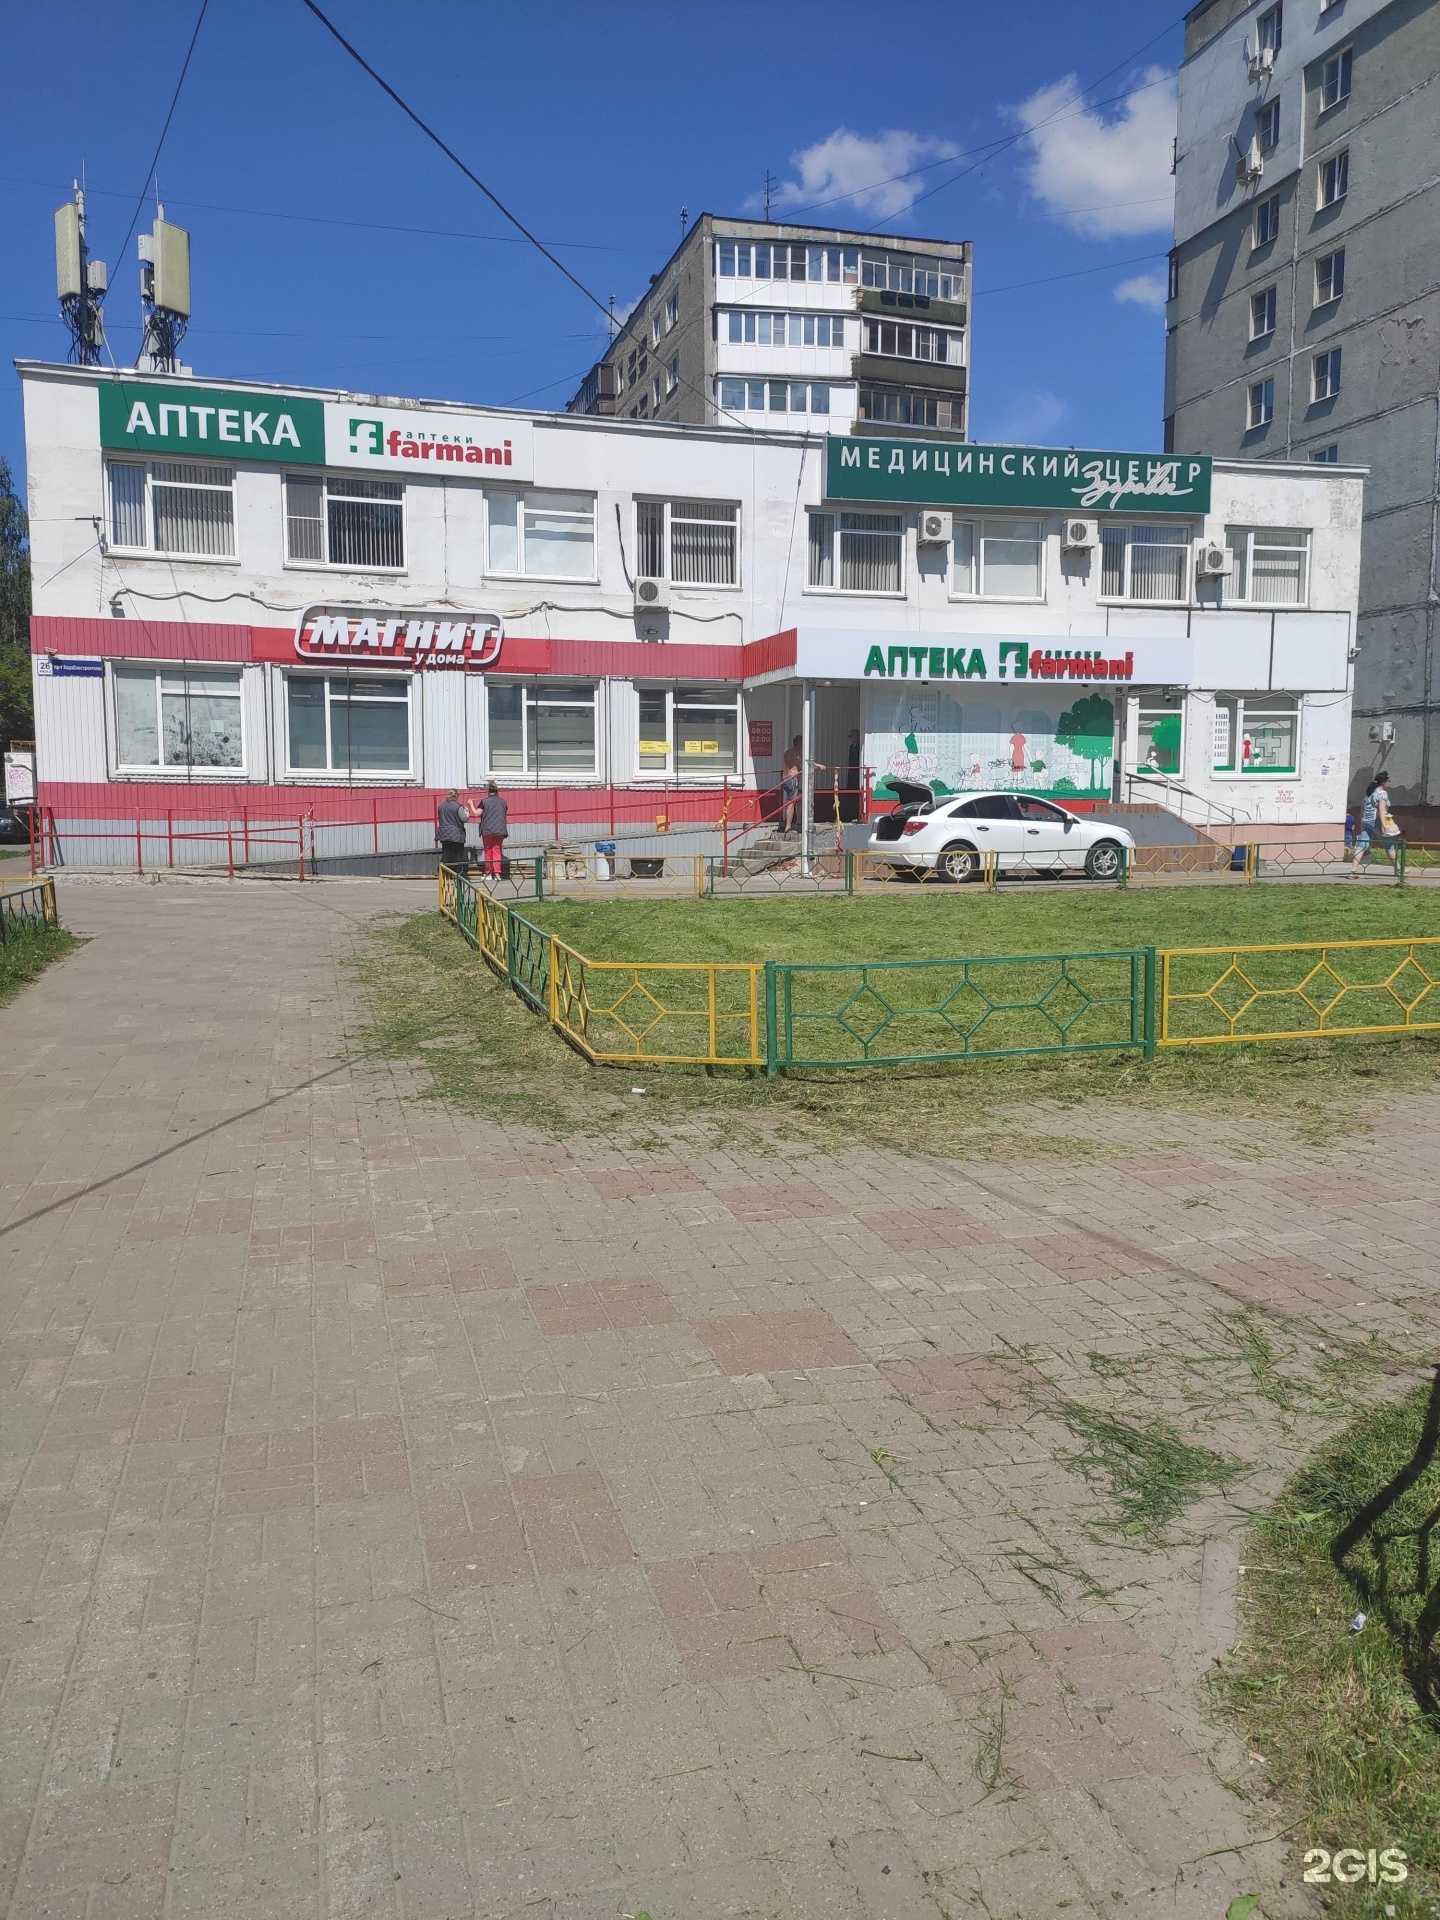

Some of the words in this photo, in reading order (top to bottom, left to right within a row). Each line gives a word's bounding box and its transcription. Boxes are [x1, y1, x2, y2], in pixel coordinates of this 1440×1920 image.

[126, 401, 302, 448] АПТЕКА
[405, 431, 474, 444] аптеки
[387, 430, 512, 466] farmani
[840, 446, 1079, 479] МЕДИЦИНСКИЙ
[1105, 458, 1201, 483] ЦЕНТР
[308, 615, 493, 651] МАГНИТ
[40, 662, 51, 670] 26
[415, 653, 425, 665] у
[426, 654, 465, 665] дома
[864, 645, 987, 677] АПТЕКА
[1029, 649, 1134, 679] farmani
